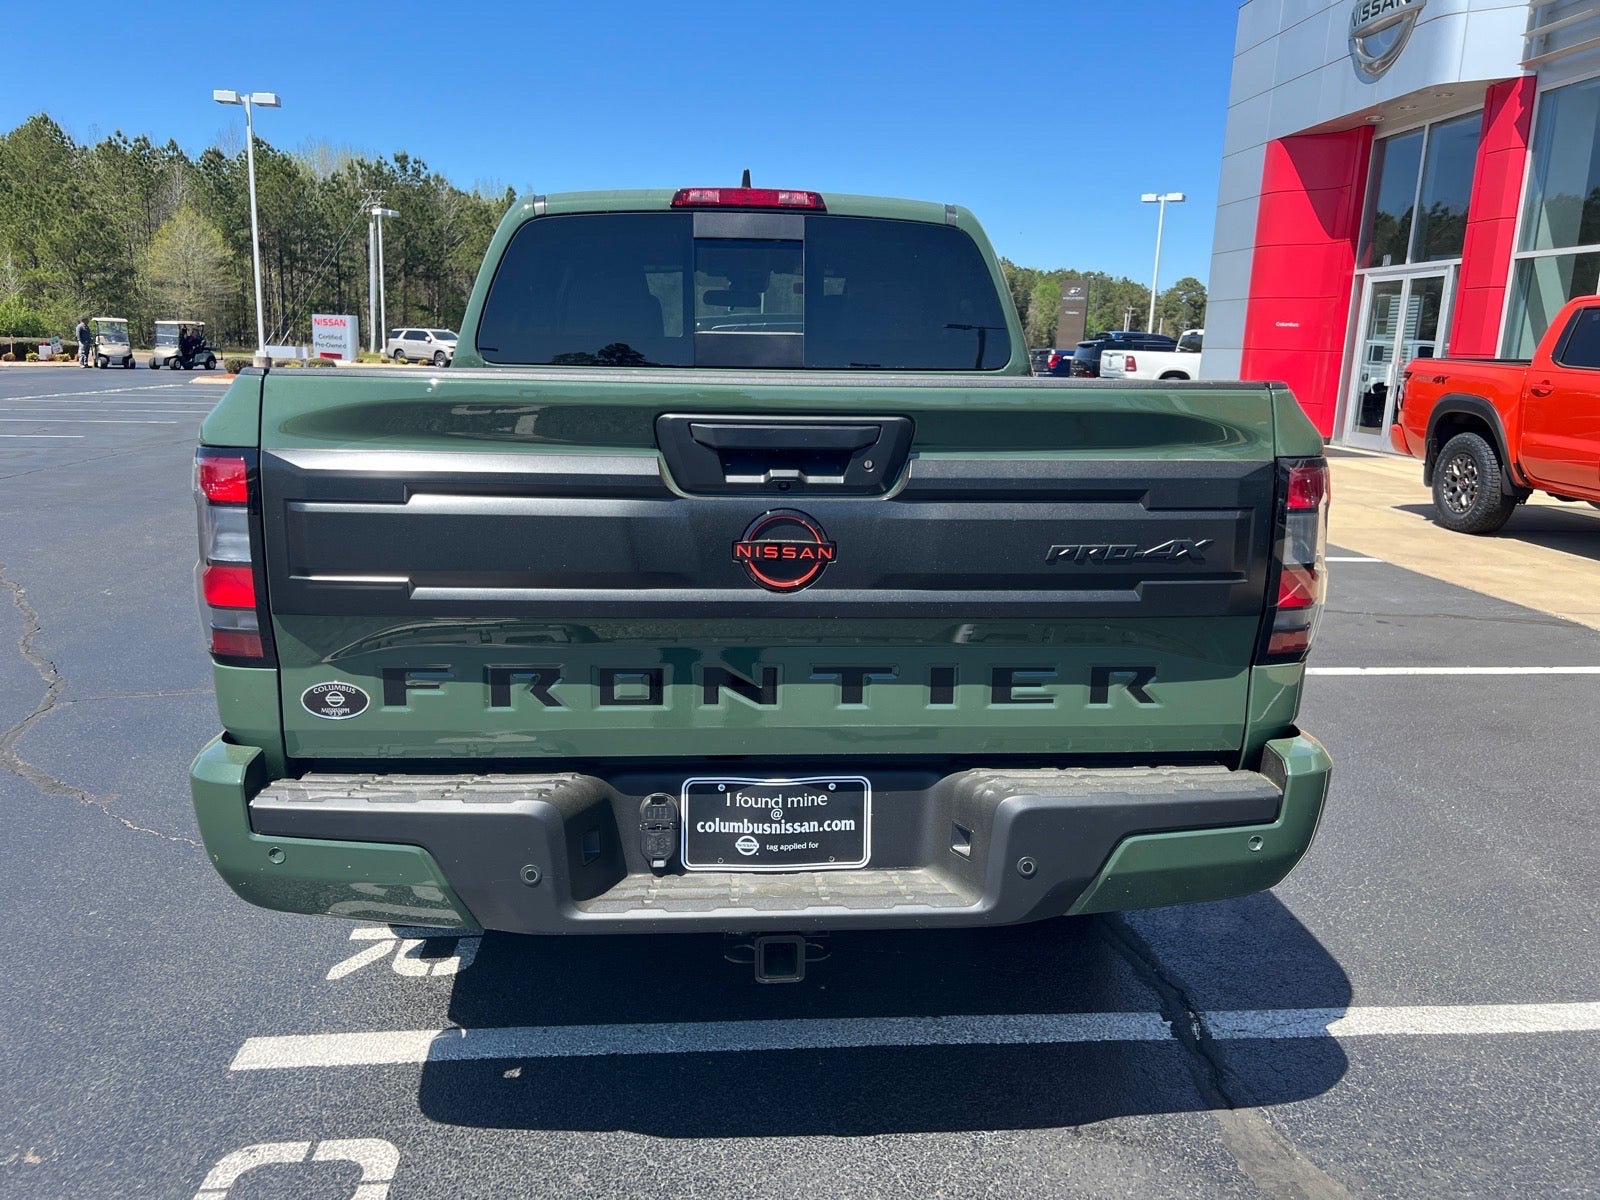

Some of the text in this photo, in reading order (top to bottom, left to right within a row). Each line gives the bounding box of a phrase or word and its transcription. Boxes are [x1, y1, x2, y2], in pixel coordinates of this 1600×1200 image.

[314, 318, 346, 327] NISSAN
[318, 333, 343, 341] Certified
[315, 341, 347, 349] Pre-Owned
[736, 544, 833, 559] NISSAN
[1045, 538, 1214, 566] PRO-4X
[313, 684, 356, 694] COLUMBUS
[381, 665, 1161, 710] FRONTIER
[726, 792, 828, 809] I found mine
[770, 808, 783, 821] @
[696, 818, 856, 835] columbusnissan.com
[766, 841, 819, 852] tag applied for
